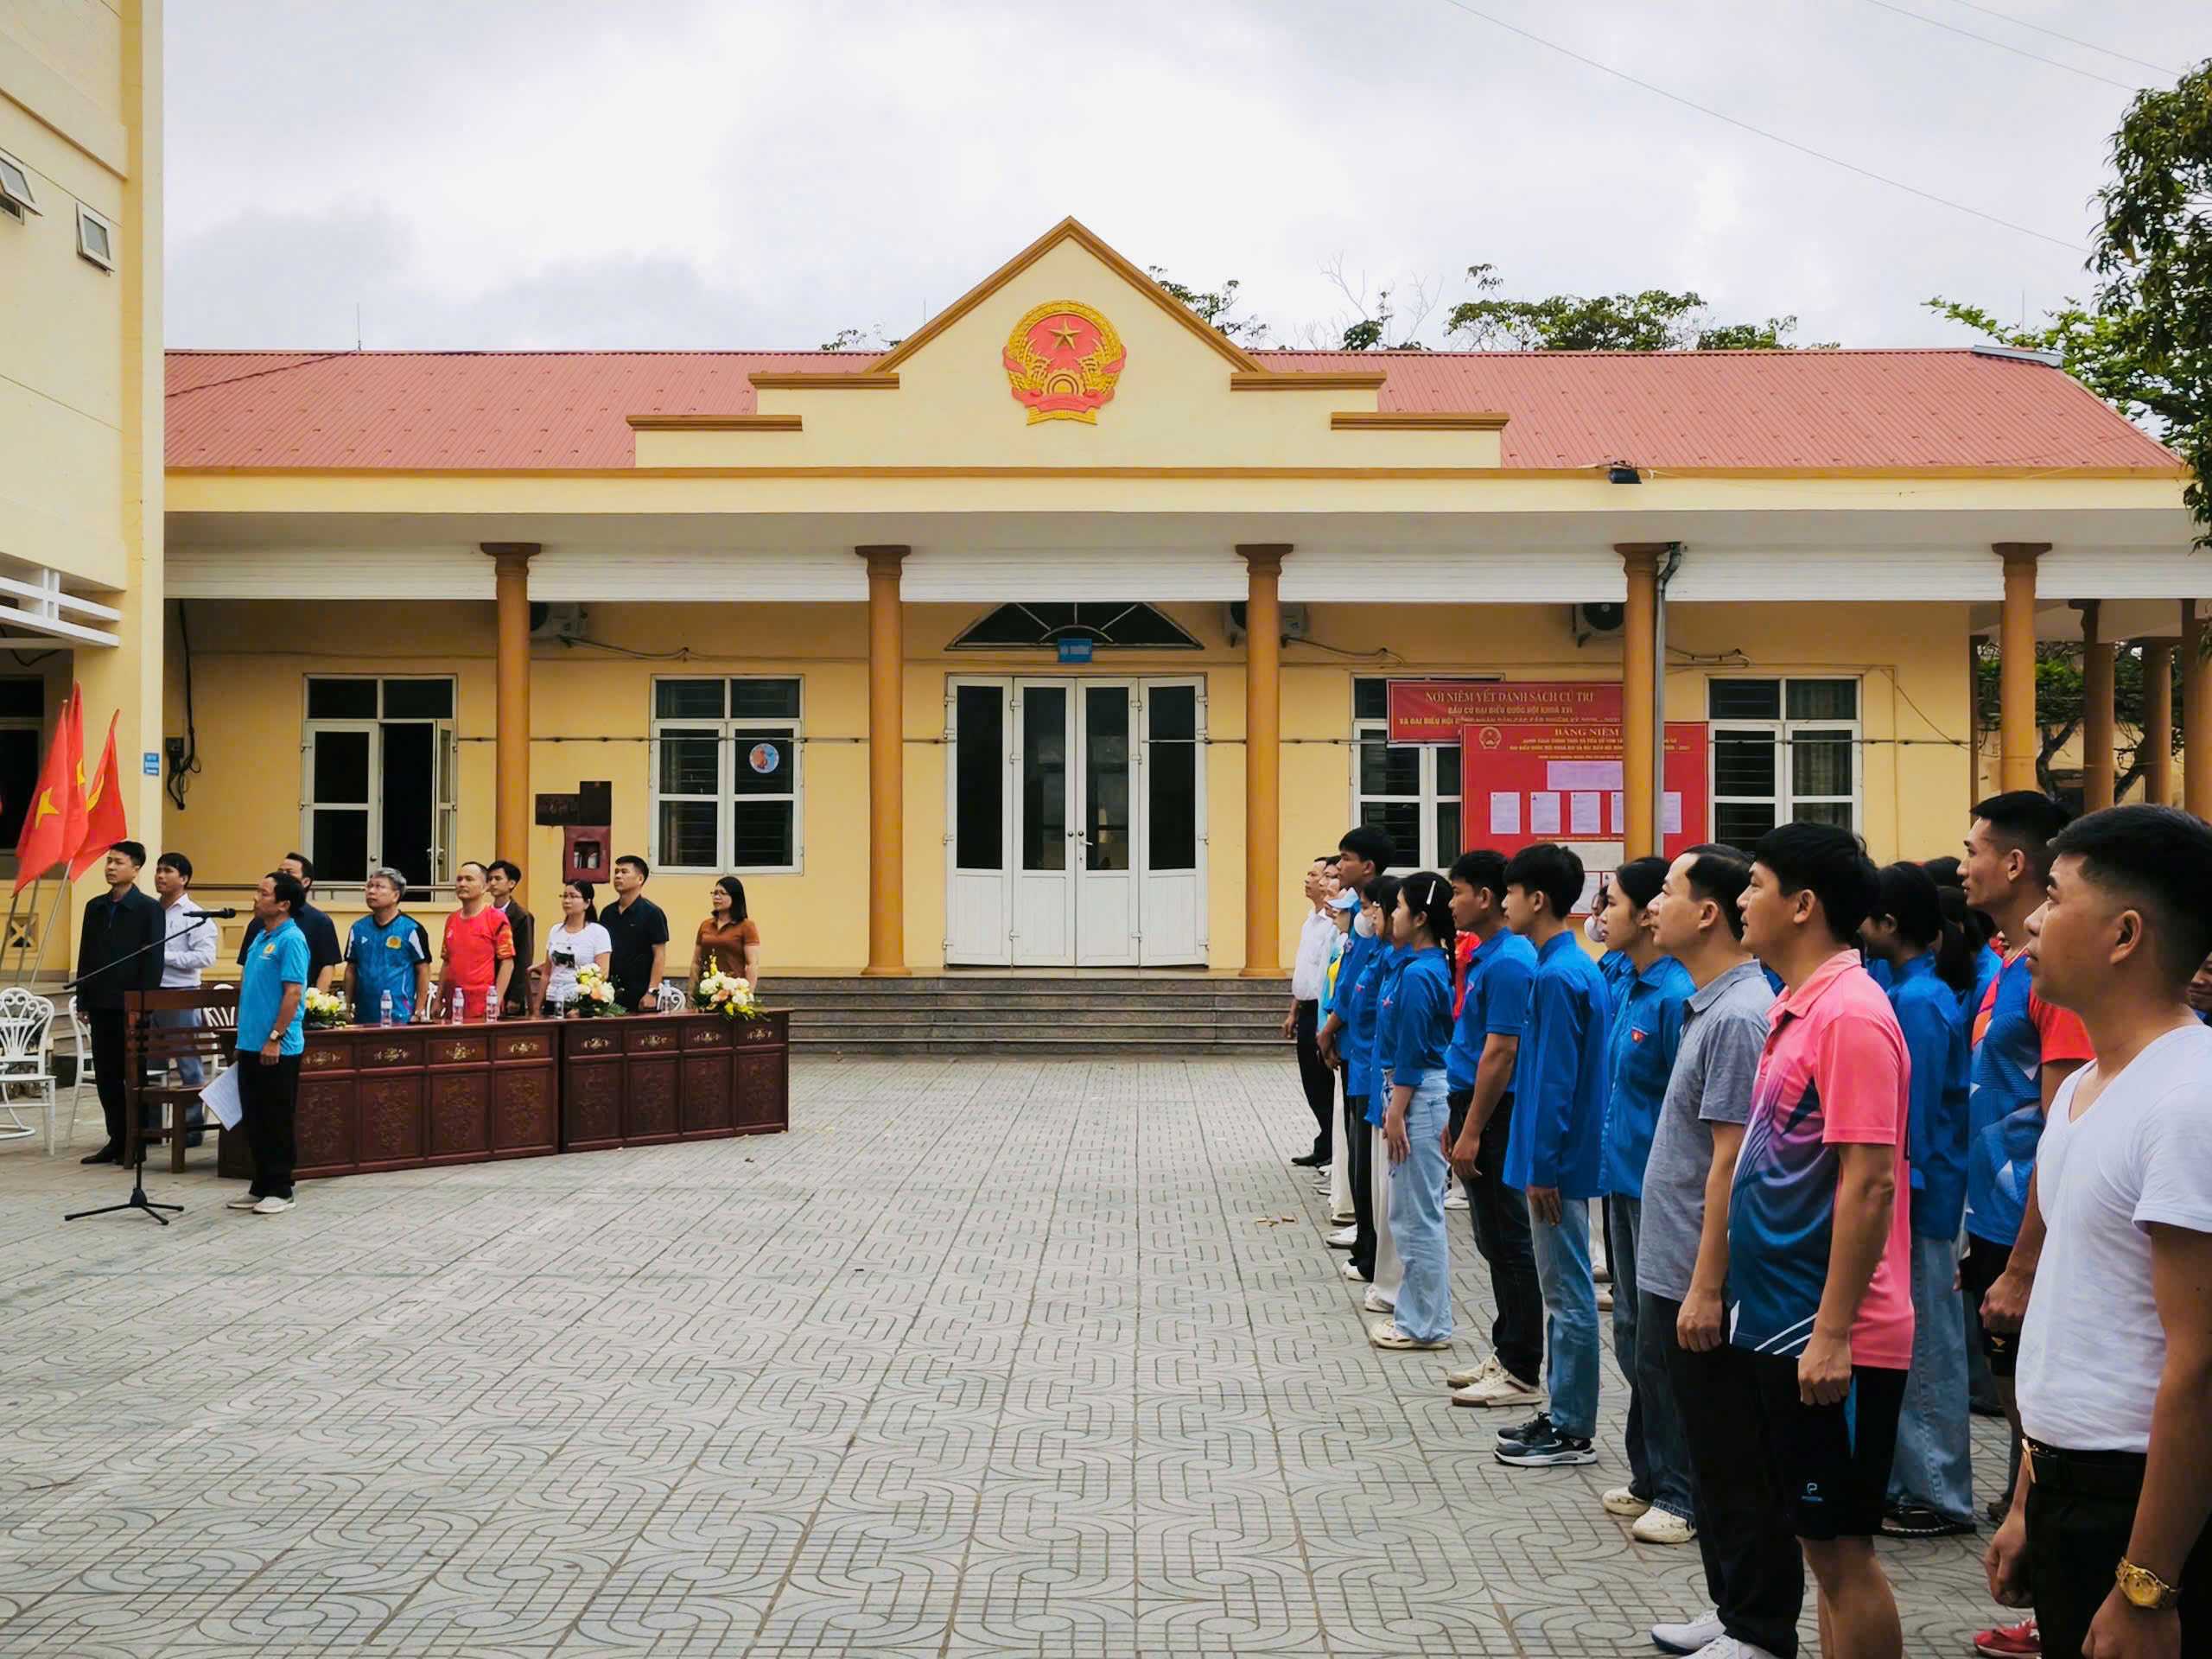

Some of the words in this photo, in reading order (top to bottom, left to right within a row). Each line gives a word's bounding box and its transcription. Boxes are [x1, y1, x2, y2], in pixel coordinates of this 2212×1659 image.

[1427, 690, 1445, 702] NƠI
[1447, 690, 1473, 702] NIÊM
[1476, 687, 1496, 702] YẾT
[1498, 691, 1528, 702] DANH
[1529, 690, 1557, 702] SÁCH
[1576, 691, 1593, 702] TRI
[1554, 727, 1586, 736] BẢNG
[1589, 726, 1619, 736] NIÊM
